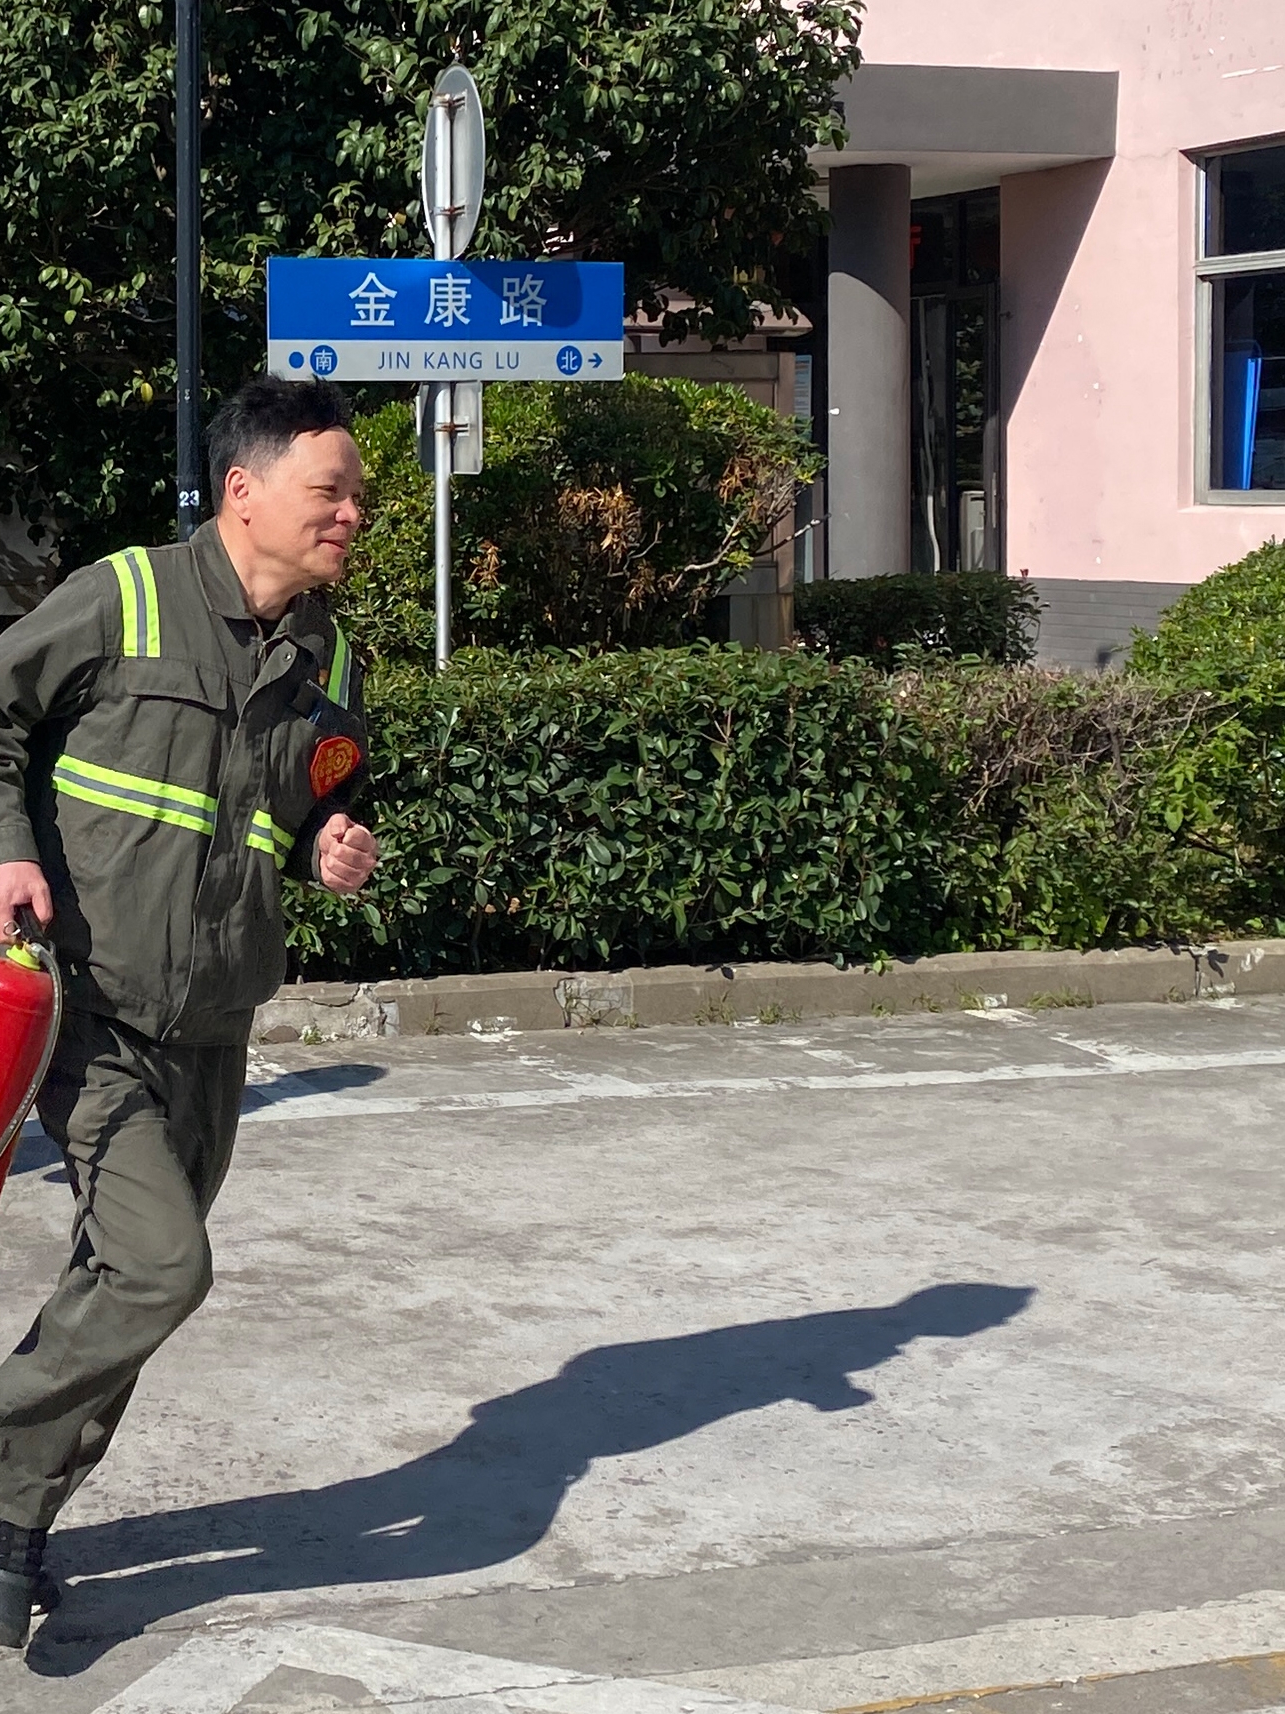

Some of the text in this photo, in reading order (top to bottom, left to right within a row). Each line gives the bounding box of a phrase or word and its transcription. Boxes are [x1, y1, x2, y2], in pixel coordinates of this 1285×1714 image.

[348, 272, 547, 327] 金康路
[314, 350, 336, 371] 南
[378, 351, 520, 370] JIN KANG LU
[561, 351, 579, 370] 北
[179, 490, 200, 507] 23
